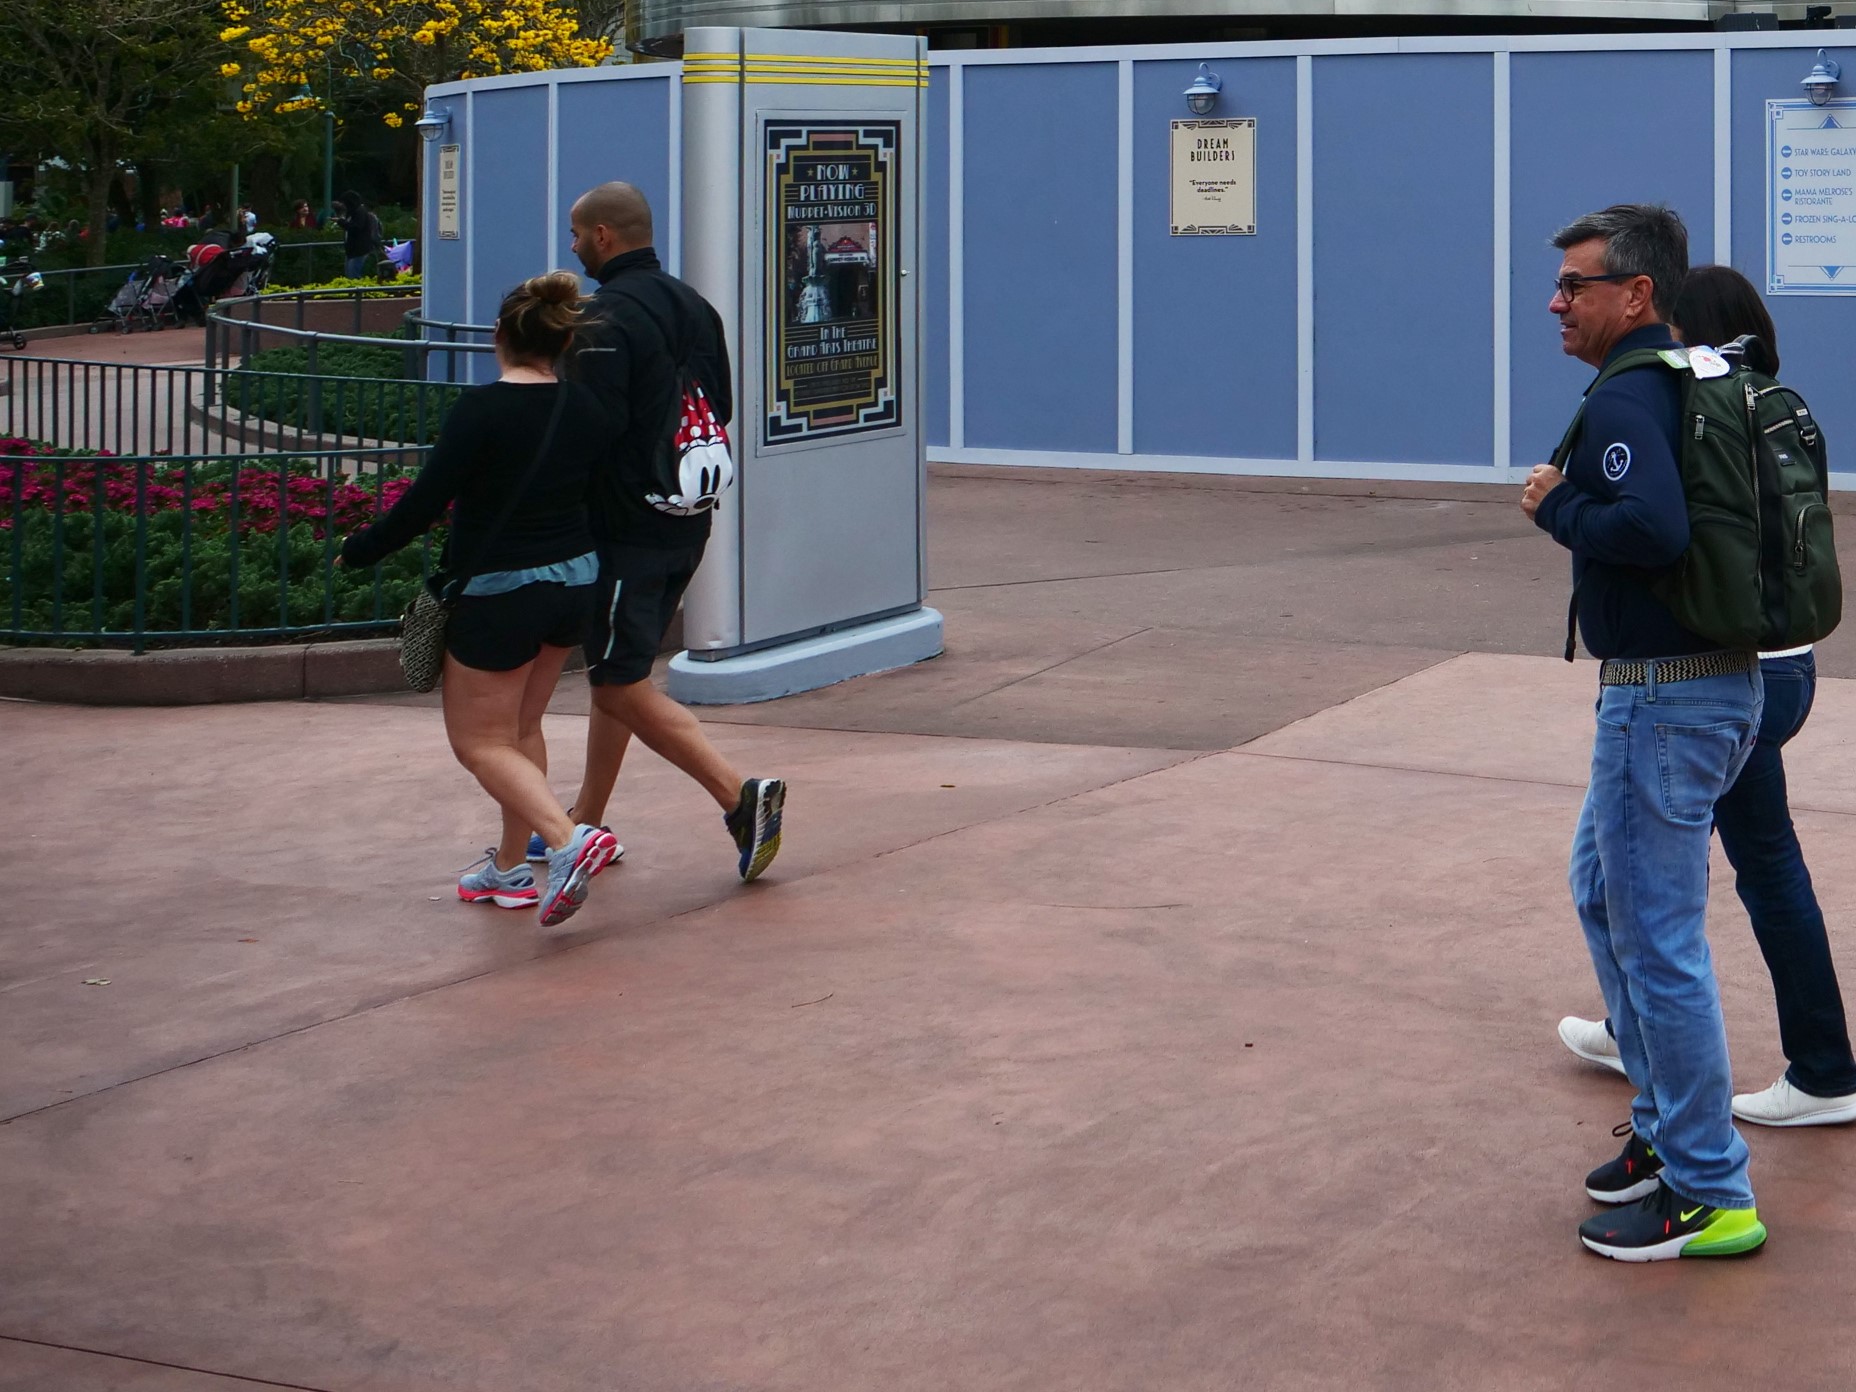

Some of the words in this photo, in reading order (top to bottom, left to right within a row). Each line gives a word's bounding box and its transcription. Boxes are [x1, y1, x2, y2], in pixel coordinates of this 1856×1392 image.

[1197, 138, 1228, 149] DREAM
[1191, 151, 1235, 161] BUILDERS
[1794, 148, 1808, 156] STAR
[817, 165, 849, 180] NOW
[1795, 169, 1808, 177] TOY
[800, 184, 865, 201] PLAYING
[1795, 188, 1816, 196] MAMA
[864, 203, 876, 215] 3D
[787, 345, 818, 358] GRAND
[820, 341, 840, 354] ARTS
[843, 338, 877, 352] THEATRE
